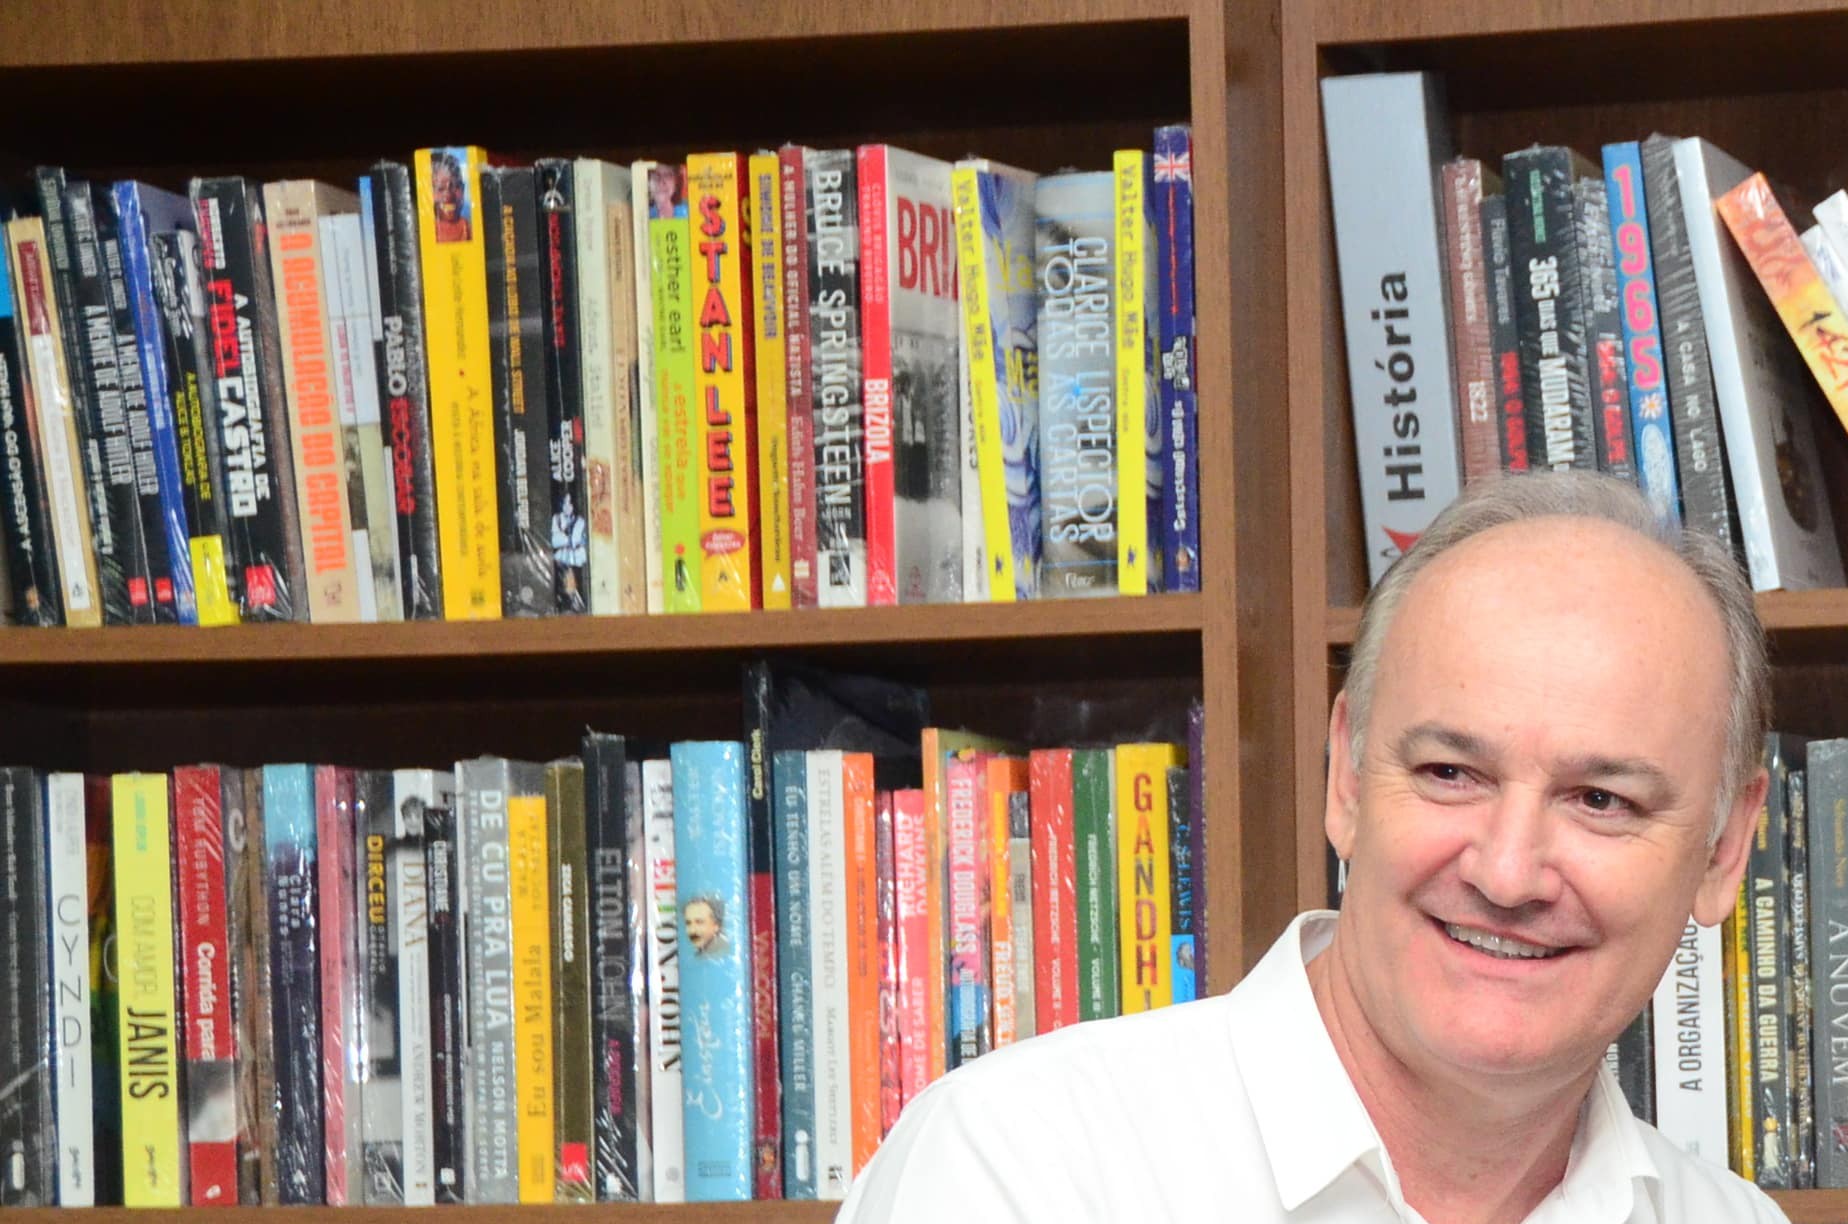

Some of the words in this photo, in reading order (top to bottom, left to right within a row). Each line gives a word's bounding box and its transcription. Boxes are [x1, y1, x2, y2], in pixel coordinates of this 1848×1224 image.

[814, 170, 845, 278] BRUCE
[665, 231, 685, 302] esther
[698, 194, 734, 375] STAN
[1044, 238, 1074, 360] TODAS
[1072, 237, 1111, 357] CLARICE
[1612, 164, 1662, 390] 1965
[207, 280, 239, 378] FIDEL
[384, 316, 408, 397] PABLO
[669, 312, 686, 353] earl
[818, 290, 852, 505] SPRINGSTEEN
[864, 378, 891, 465] BRIZOLA
[1048, 372, 1078, 410] AS
[1372, 271, 1425, 503] História
[218, 377, 258, 517] CASTRO
[390, 400, 415, 514] ESCOBAR
[550, 439, 562, 481] ALICE
[562, 421, 574, 481] COOPER
[704, 384, 734, 518] LEE
[1048, 422, 1081, 544] CARTAS
[1076, 370, 1114, 543] LISPECTOR
[479, 789, 502, 827] DE
[951, 777, 974, 866] FREDERICK
[367, 835, 387, 924] DIRCEU
[480, 842, 503, 882] CU
[594, 851, 623, 939] ELTON
[1132, 772, 1158, 1010] GANDHI
[1754, 878, 1771, 890] A
[401, 861, 428, 948] DIANA
[481, 900, 507, 957] PRA
[953, 870, 978, 954] DOUGLASS
[1755, 895, 1776, 978] CAMINHO
[57, 894, 83, 1088] CYNDI
[195, 942, 216, 1015] Corrida
[485, 969, 511, 1030] LUA
[524, 945, 547, 1026] Malala
[596, 944, 626, 1022] JOHN
[1757, 984, 1777, 1008] DA
[126, 1006, 170, 1100] JANIS
[199, 1018, 218, 1062] para
[490, 1040, 507, 1111] NELSON
[531, 1033, 547, 1076] sou
[1759, 1014, 1779, 1082] GUERRA
[528, 1085, 547, 1118] Eu
[493, 1119, 508, 1179] MOTTA
